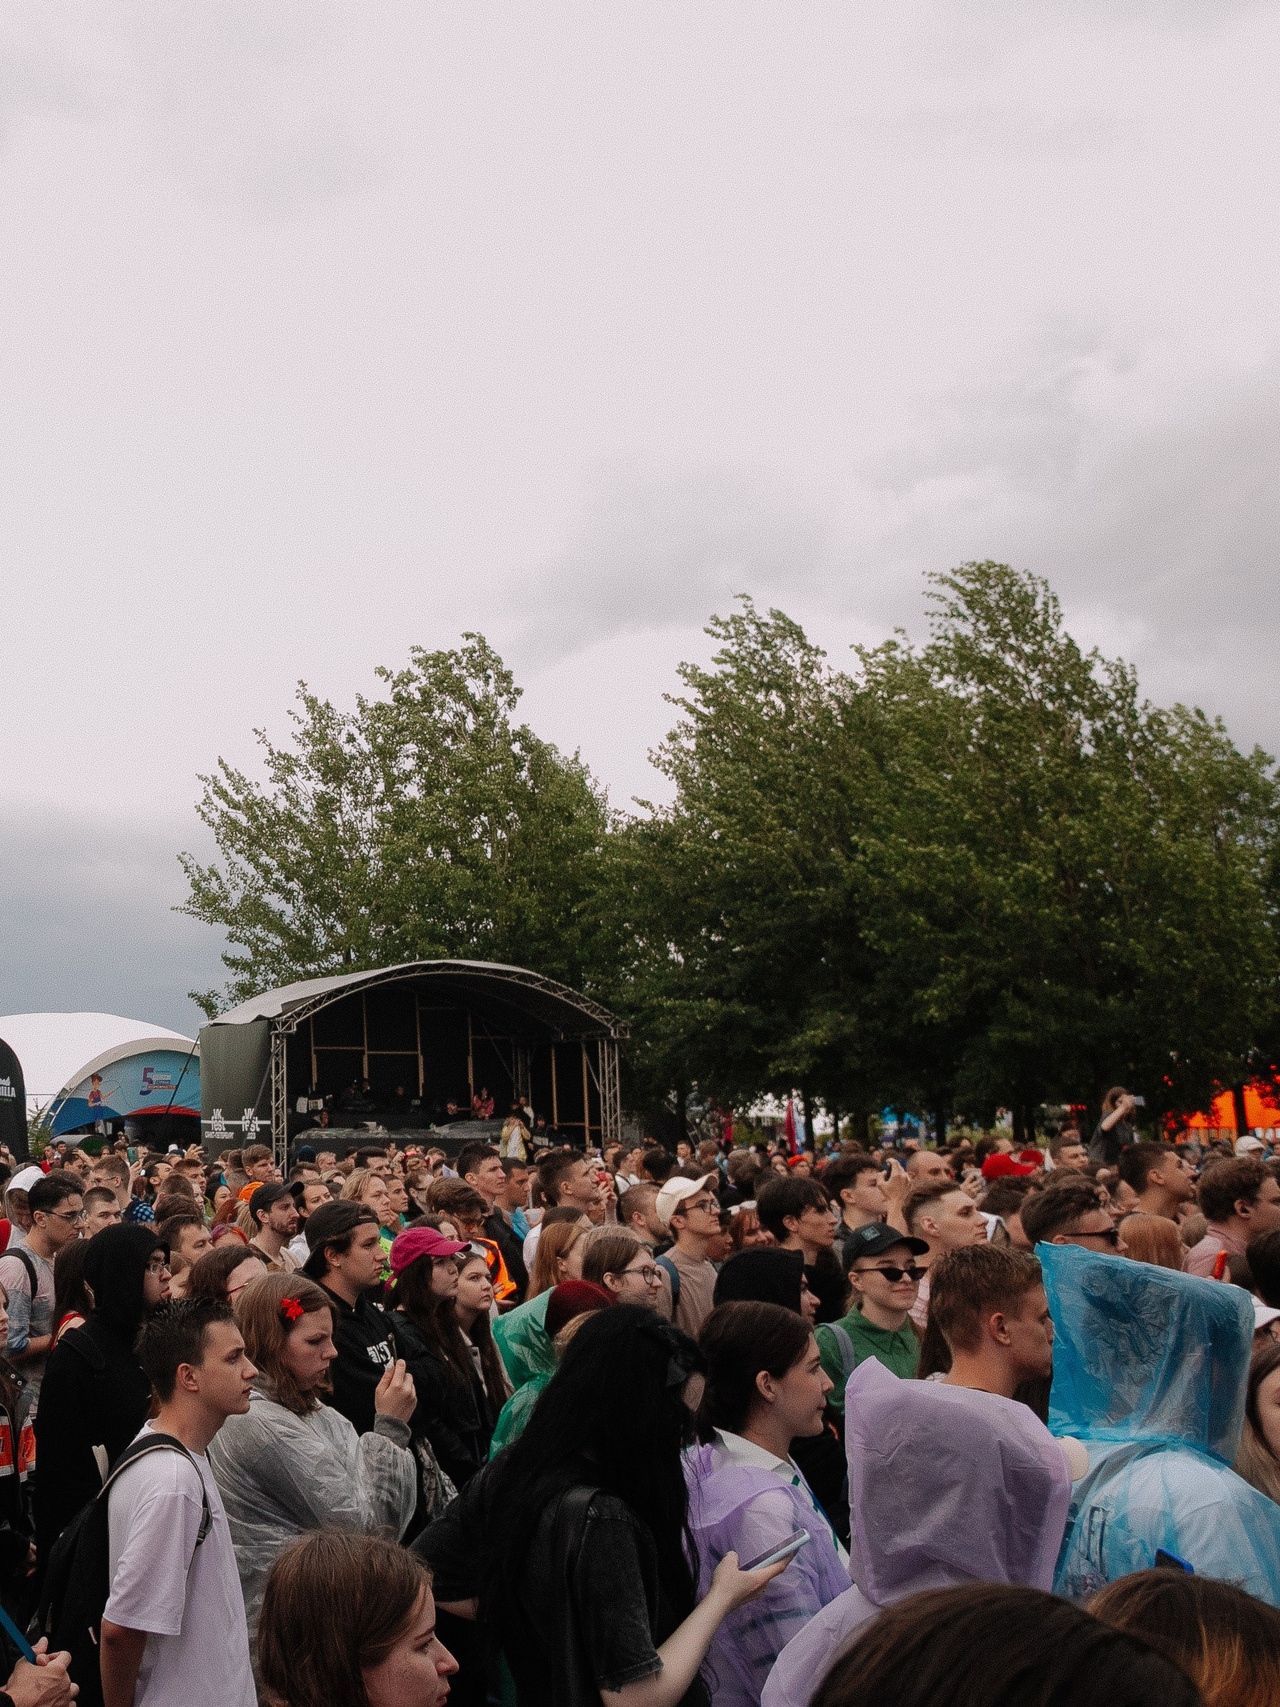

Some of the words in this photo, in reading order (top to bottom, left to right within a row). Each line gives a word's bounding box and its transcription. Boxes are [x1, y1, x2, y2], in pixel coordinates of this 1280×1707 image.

[139, 1067, 154, 1096] 5
[211, 1115, 226, 1132] fest
[241, 1115, 260, 1132] fest
